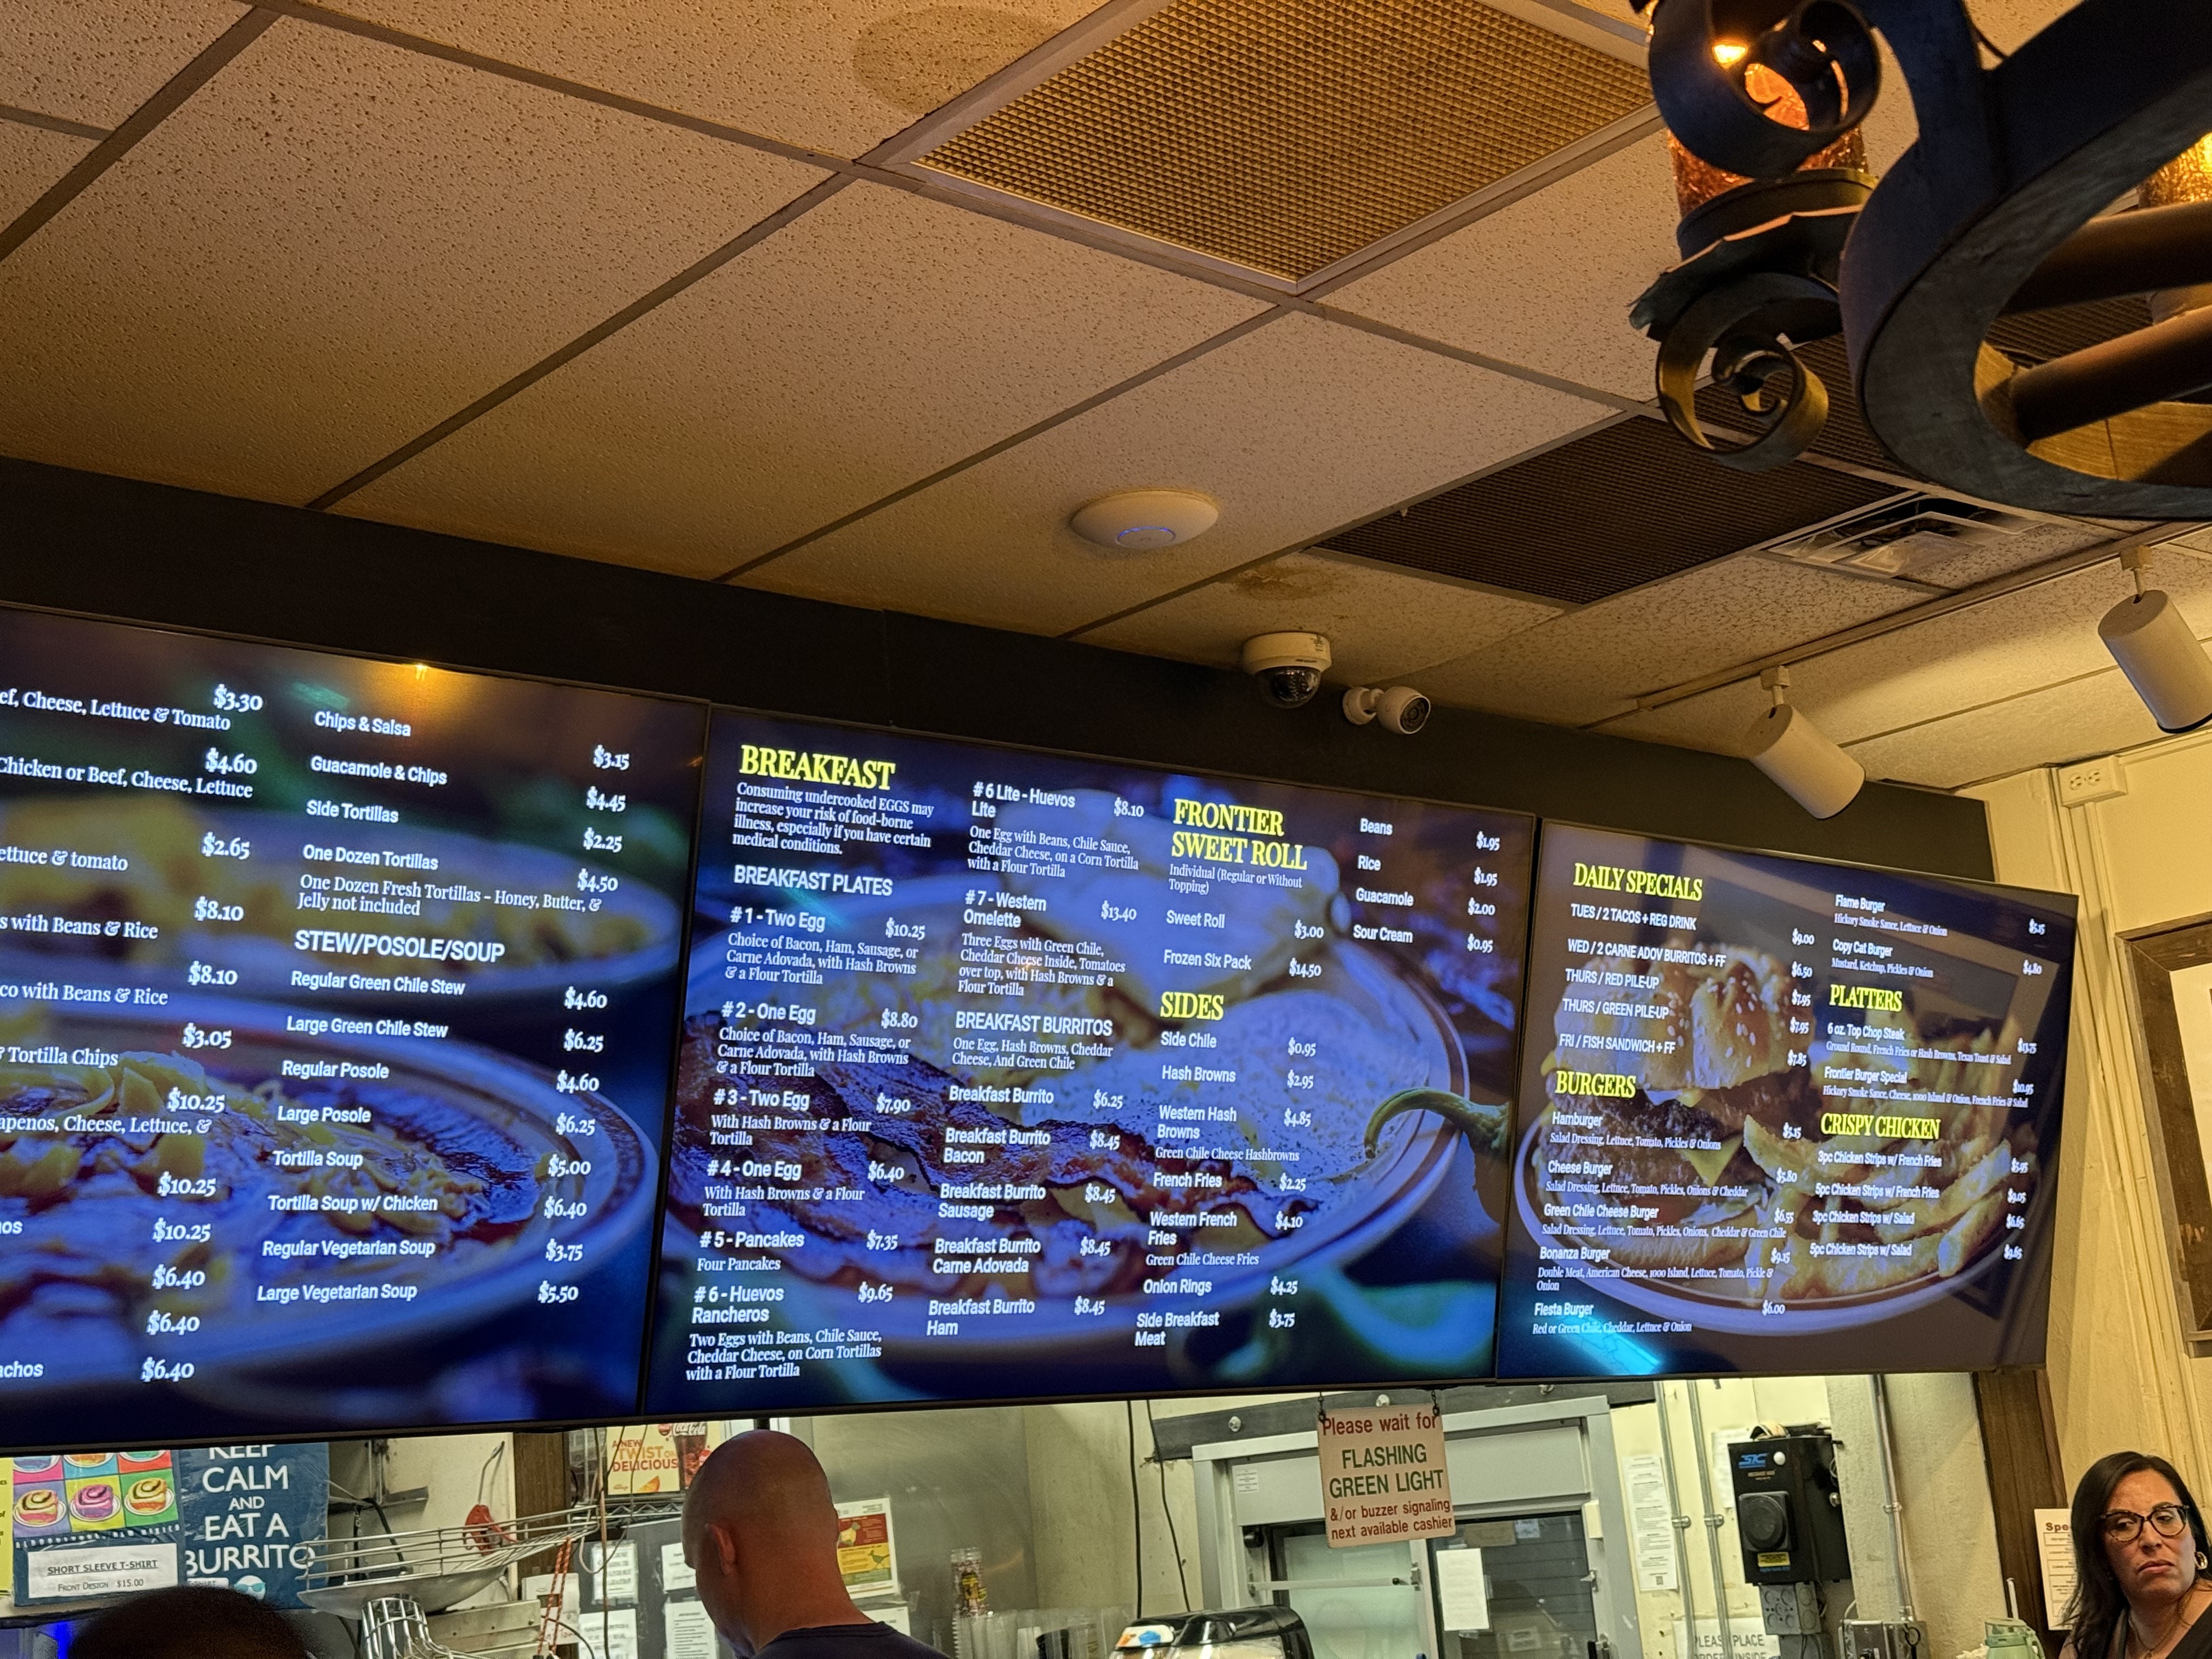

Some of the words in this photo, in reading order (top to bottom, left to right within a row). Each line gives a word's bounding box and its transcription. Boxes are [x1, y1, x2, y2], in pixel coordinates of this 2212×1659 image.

[213, 684, 263, 712] $3.30
[23, 692, 87, 714] Cheese,
[91, 700, 150, 721] Lettuce
[153, 708, 170, 721] &
[172, 709, 231, 731] Tomato
[314, 712, 357, 732] Chips
[359, 718, 370, 731] &
[372, 718, 411, 736] Salsa
[593, 745, 630, 770] $3.15
[739, 744, 895, 791] BREAKFAST
[311, 756, 392, 779] Guacamole
[394, 766, 405, 780] &
[408, 766, 447, 787] Chips
[586, 786, 626, 811] $4.45
[737, 782, 803, 803] Consuming
[805, 791, 877, 809] undercooked
[879, 798, 910, 814] EGGS
[911, 802, 934, 818] may
[306, 800, 339, 818] Side
[341, 804, 399, 823] Tortillas
[1173, 798, 1285, 837] FRONTIER
[1359, 818, 1393, 836] Beans
[583, 827, 622, 852] $2.25
[732, 833, 778, 849] medical
[781, 838, 843, 855] conditions.
[1476, 832, 1500, 851] $1.95
[303, 844, 333, 861] One
[335, 848, 380, 865] Dozen
[382, 851, 438, 870] Tortillas
[1171, 832, 1248, 863] SWEET
[1250, 843, 1307, 871] ROLL
[577, 868, 618, 892] $4.50
[733, 865, 830, 891] BREAKFAST
[832, 874, 893, 896] PLATES
[1169, 878, 1209, 895] Topping)
[1170, 864, 1216, 880] Individual
[1217, 867, 1255, 885] (Regular
[1256, 874, 1266, 884] or
[1268, 872, 1303, 889] Without
[1573, 862, 1625, 891] DAILY
[1626, 869, 1703, 901] SPECIALS
[1356, 888, 1414, 907] Guacamole
[1468, 898, 1496, 916] $2.00
[765, 910, 796, 927] Two
[799, 912, 826, 932] Egg
[1166, 910, 1201, 927] Sweet
[1204, 913, 1226, 929] Roll
[1571, 904, 1595, 918] TUES
[1602, 907, 1610, 920] 2
[1611, 909, 1641, 924] TACOS
[1650, 915, 1668, 927] REG
[1669, 916, 1697, 931] DRINK
[885, 918, 926, 940] $10.25
[1294, 920, 1324, 939] $3.00
[1353, 925, 1378, 941] Sour
[1379, 927, 1413, 943] Cream
[1792, 928, 1814, 945] $9.00
[294, 930, 505, 962] STEW/POSOLE/SOUP
[728, 932, 769, 947] Choice
[771, 935, 785, 949] of
[786, 936, 823, 952] Bacon,
[826, 940, 854, 955] Ham,
[857, 942, 903, 959] Sausage,
[905, 947, 918, 958] or
[1467, 934, 1493, 953] $0.95
[1163, 950, 1201, 966] Frozen
[1204, 953, 1221, 967] Six
[1223, 955, 1252, 970] Pack
[1289, 958, 1322, 978] $14.50
[291, 971, 346, 990] Regular
[349, 974, 391, 991] Green
[394, 976, 430, 992] Chile
[432, 979, 465, 995] Stew
[1565, 968, 1596, 984] THURS
[1605, 973, 1623, 986] RED
[1624, 974, 1660, 989] PILE-UP
[565, 986, 607, 1009] $4.60
[1160, 991, 1224, 1021] SIDES
[1791, 989, 1811, 1006] $7.95
[1829, 984, 1903, 1013] PLATTERS
[955, 1011, 1041, 1033] BREAKFAST
[1042, 1016, 1113, 1036] BURRITOS
[1161, 1031, 1186, 1046] Side
[1188, 1033, 1217, 1049] Chile
[1288, 1037, 1316, 1057] $0.95
[8, 1047, 69, 1065] Tortilla
[72, 1048, 119, 1066] Chips
[1555, 1070, 1637, 1098] BURGERS
[1824, 1066, 1853, 1080] Frontier
[1854, 1069, 1880, 1083] Burger
[1881, 1070, 1908, 1084] Special
[950, 1085, 1011, 1103] Breakfast
[1013, 1087, 1054, 1104] Burrito
[1093, 1090, 1123, 1109] $6.25
[278, 1106, 319, 1125] Large
[321, 1107, 371, 1122] Posole
[556, 1113, 596, 1136] $6.25
[1552, 1111, 1603, 1127] Hamburger
[1821, 1113, 1874, 1136] CRISPY
[1875, 1115, 1941, 1139] CHICKEN
[1548, 1160, 1581, 1174] Cheese
[1583, 1161, 1613, 1177] Burger
[1776, 1169, 1797, 1184] $5.80
[268, 1195, 319, 1211] Tortilla
[321, 1196, 359, 1213] Soup
[383, 1195, 438, 1211] Chicken
[544, 1195, 588, 1219] $6.40
[1143, 1279, 1177, 1294] Onion
[1180, 1279, 1212, 1295] Rings
[1271, 1277, 1297, 1295] $4.25
[1322, 1415, 1373, 1436] Please
[1379, 1413, 1410, 1431] wait
[1416, 1411, 1437, 1430] for
[619, 1446, 663, 1459] TWIST
[620, 1439, 642, 1448] NEW
[612, 1458, 679, 1471] DELICIOUS
[1342, 1443, 1427, 1469] FLASHING
[202, 1465, 289, 1493] CALM
[1329, 1474, 1389, 1499] GREEN
[1396, 1469, 1444, 1492] LIGHT
[228, 1496, 265, 1511] AND
[1362, 1504, 1398, 1519] buzzer
[1403, 1498, 1451, 1515] signaling
[204, 1513, 261, 1542] EAT
[266, 1513, 290, 1538] A
[1331, 1527, 1356, 1540] next
[1360, 1521, 1408, 1536] available
[1413, 1516, 1453, 1532] cashier
[47, 1564, 81, 1575] SHORT
[83, 1562, 117, 1573] SLEEVE
[120, 1560, 158, 1570] T-SHIRT
[116, 1578, 144, 1588] $15.00
[1733, 1634, 1764, 1646] PLACE
